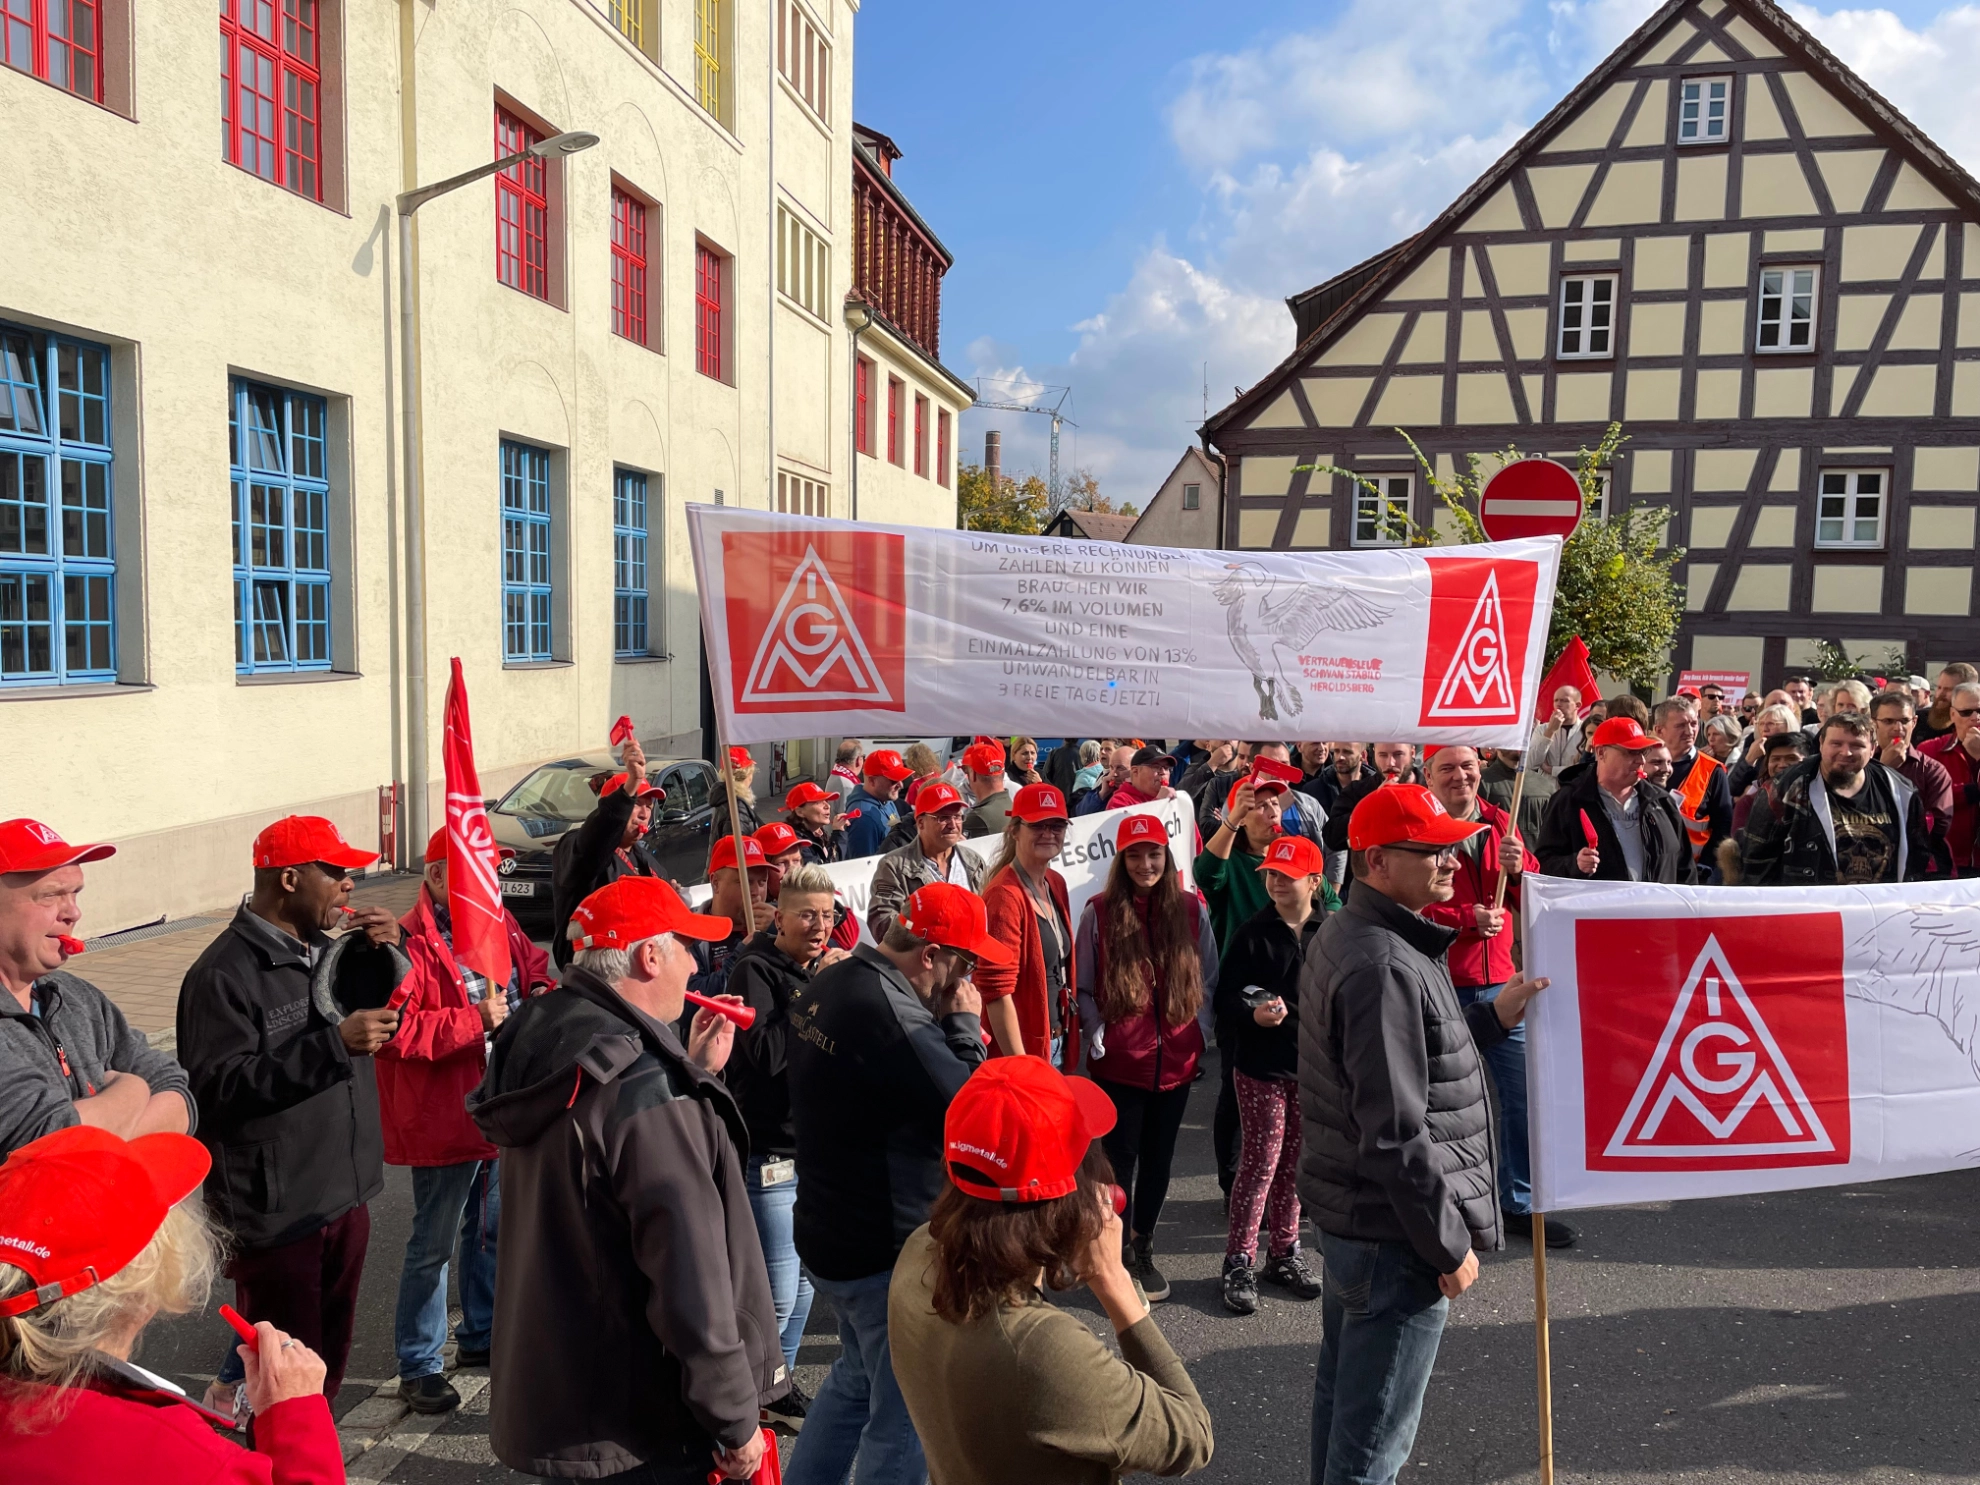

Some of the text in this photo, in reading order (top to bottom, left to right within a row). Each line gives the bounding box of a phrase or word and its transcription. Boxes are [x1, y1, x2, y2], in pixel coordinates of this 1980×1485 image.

[971, 541, 999, 554] UM
[998, 557, 1170, 574] ZAHLEN ZU KÖNNEN
[1018, 579, 1148, 595] BRAUCHEN WIR
[1001, 597, 1163, 617] 7,6% IM VOLUMEN
[1045, 621, 1129, 639] UND EINE
[968, 638, 1198, 664] EINMALZAHLUNG VON 13%
[1003, 660, 1159, 685] UMWANDELBAR IN
[998, 683, 1160, 707] 3 FREIE TAGE JETZT!
[1310, 681, 1374, 693] HEROLDSBERG
[511, 881, 531, 894] 623
